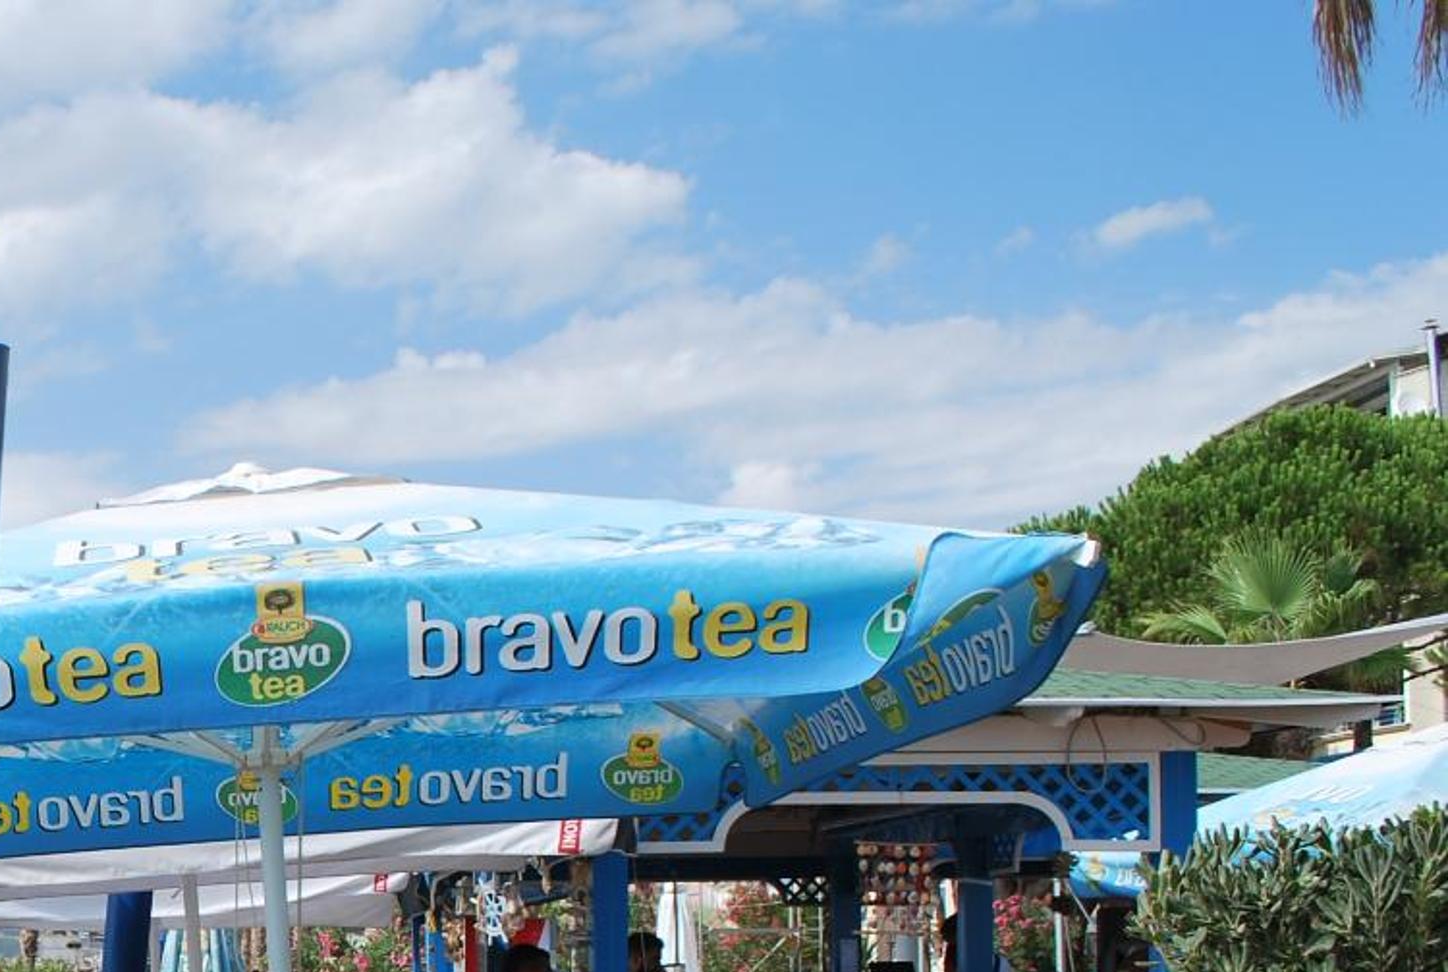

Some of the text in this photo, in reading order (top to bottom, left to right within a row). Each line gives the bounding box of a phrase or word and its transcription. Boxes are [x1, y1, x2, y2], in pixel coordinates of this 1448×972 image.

[232, 643, 331, 674] bravo
[406, 588, 811, 679] bravo tea
[19, 635, 163, 706] tea
[248, 672, 305, 700] tea
